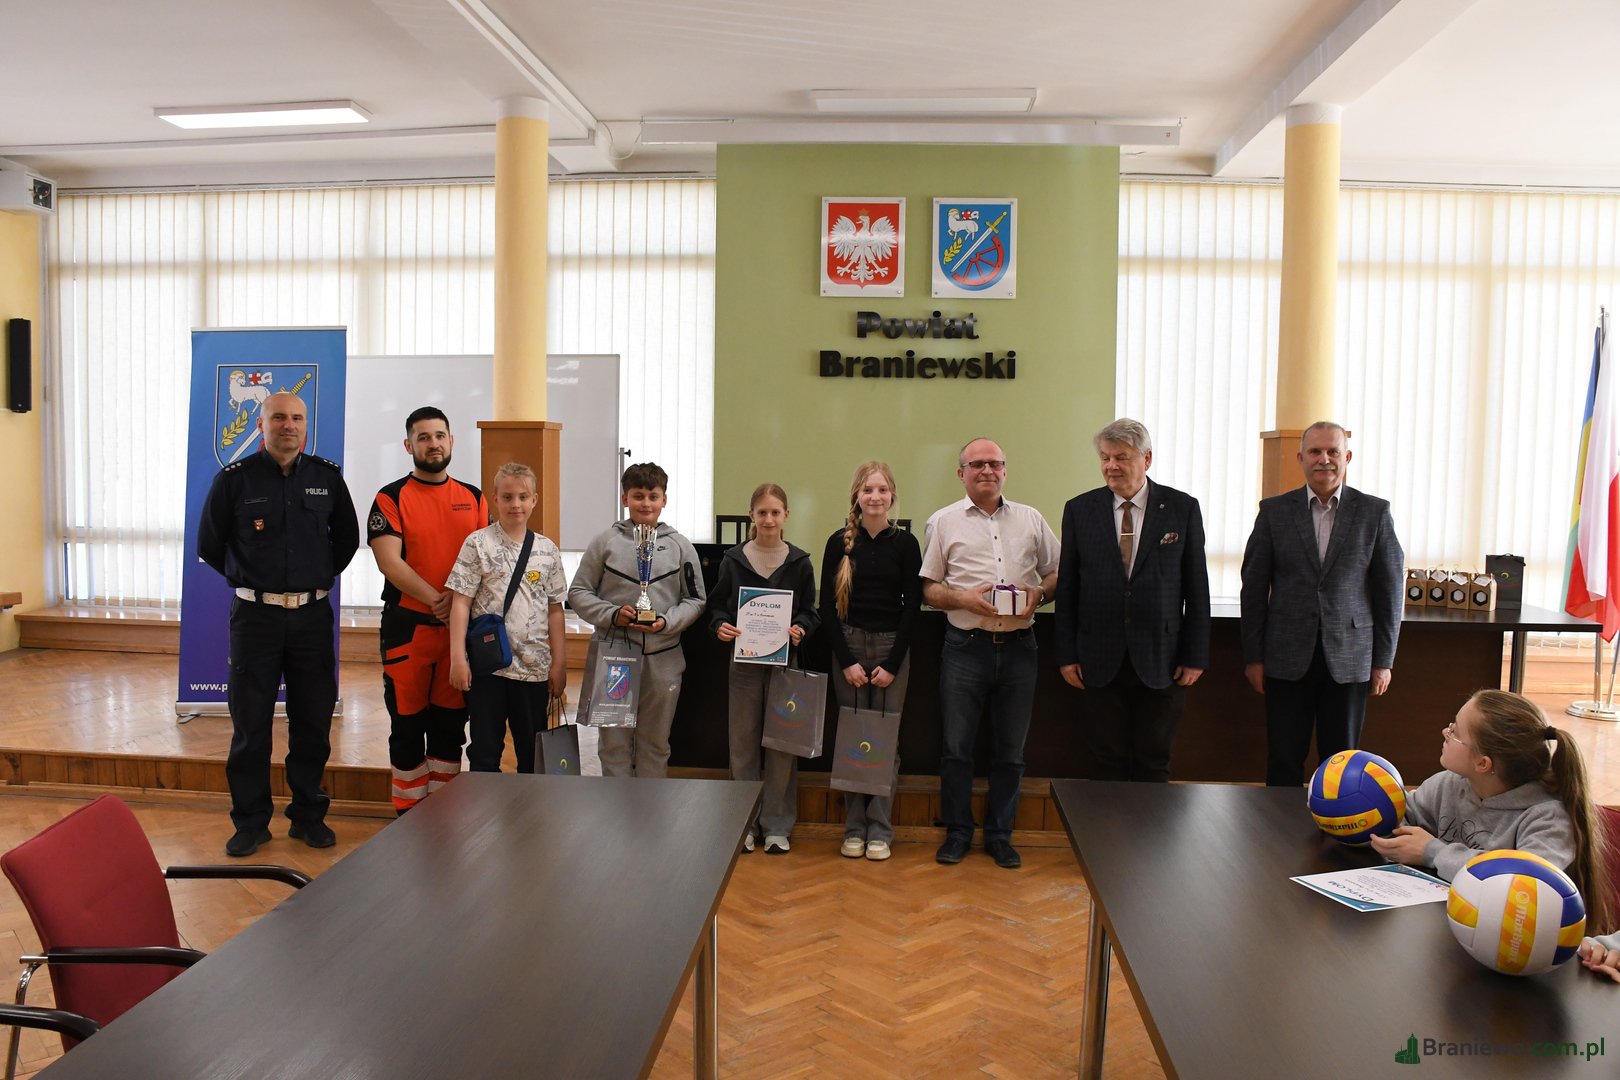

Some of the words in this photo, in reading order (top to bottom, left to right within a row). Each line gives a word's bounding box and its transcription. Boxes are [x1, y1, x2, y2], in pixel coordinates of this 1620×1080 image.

[856, 310, 979, 340] Powiat
[819, 350, 1017, 379] Braniewski
[305, 487, 329, 496] POLICJA
[749, 600, 781, 609] DYPLOM
